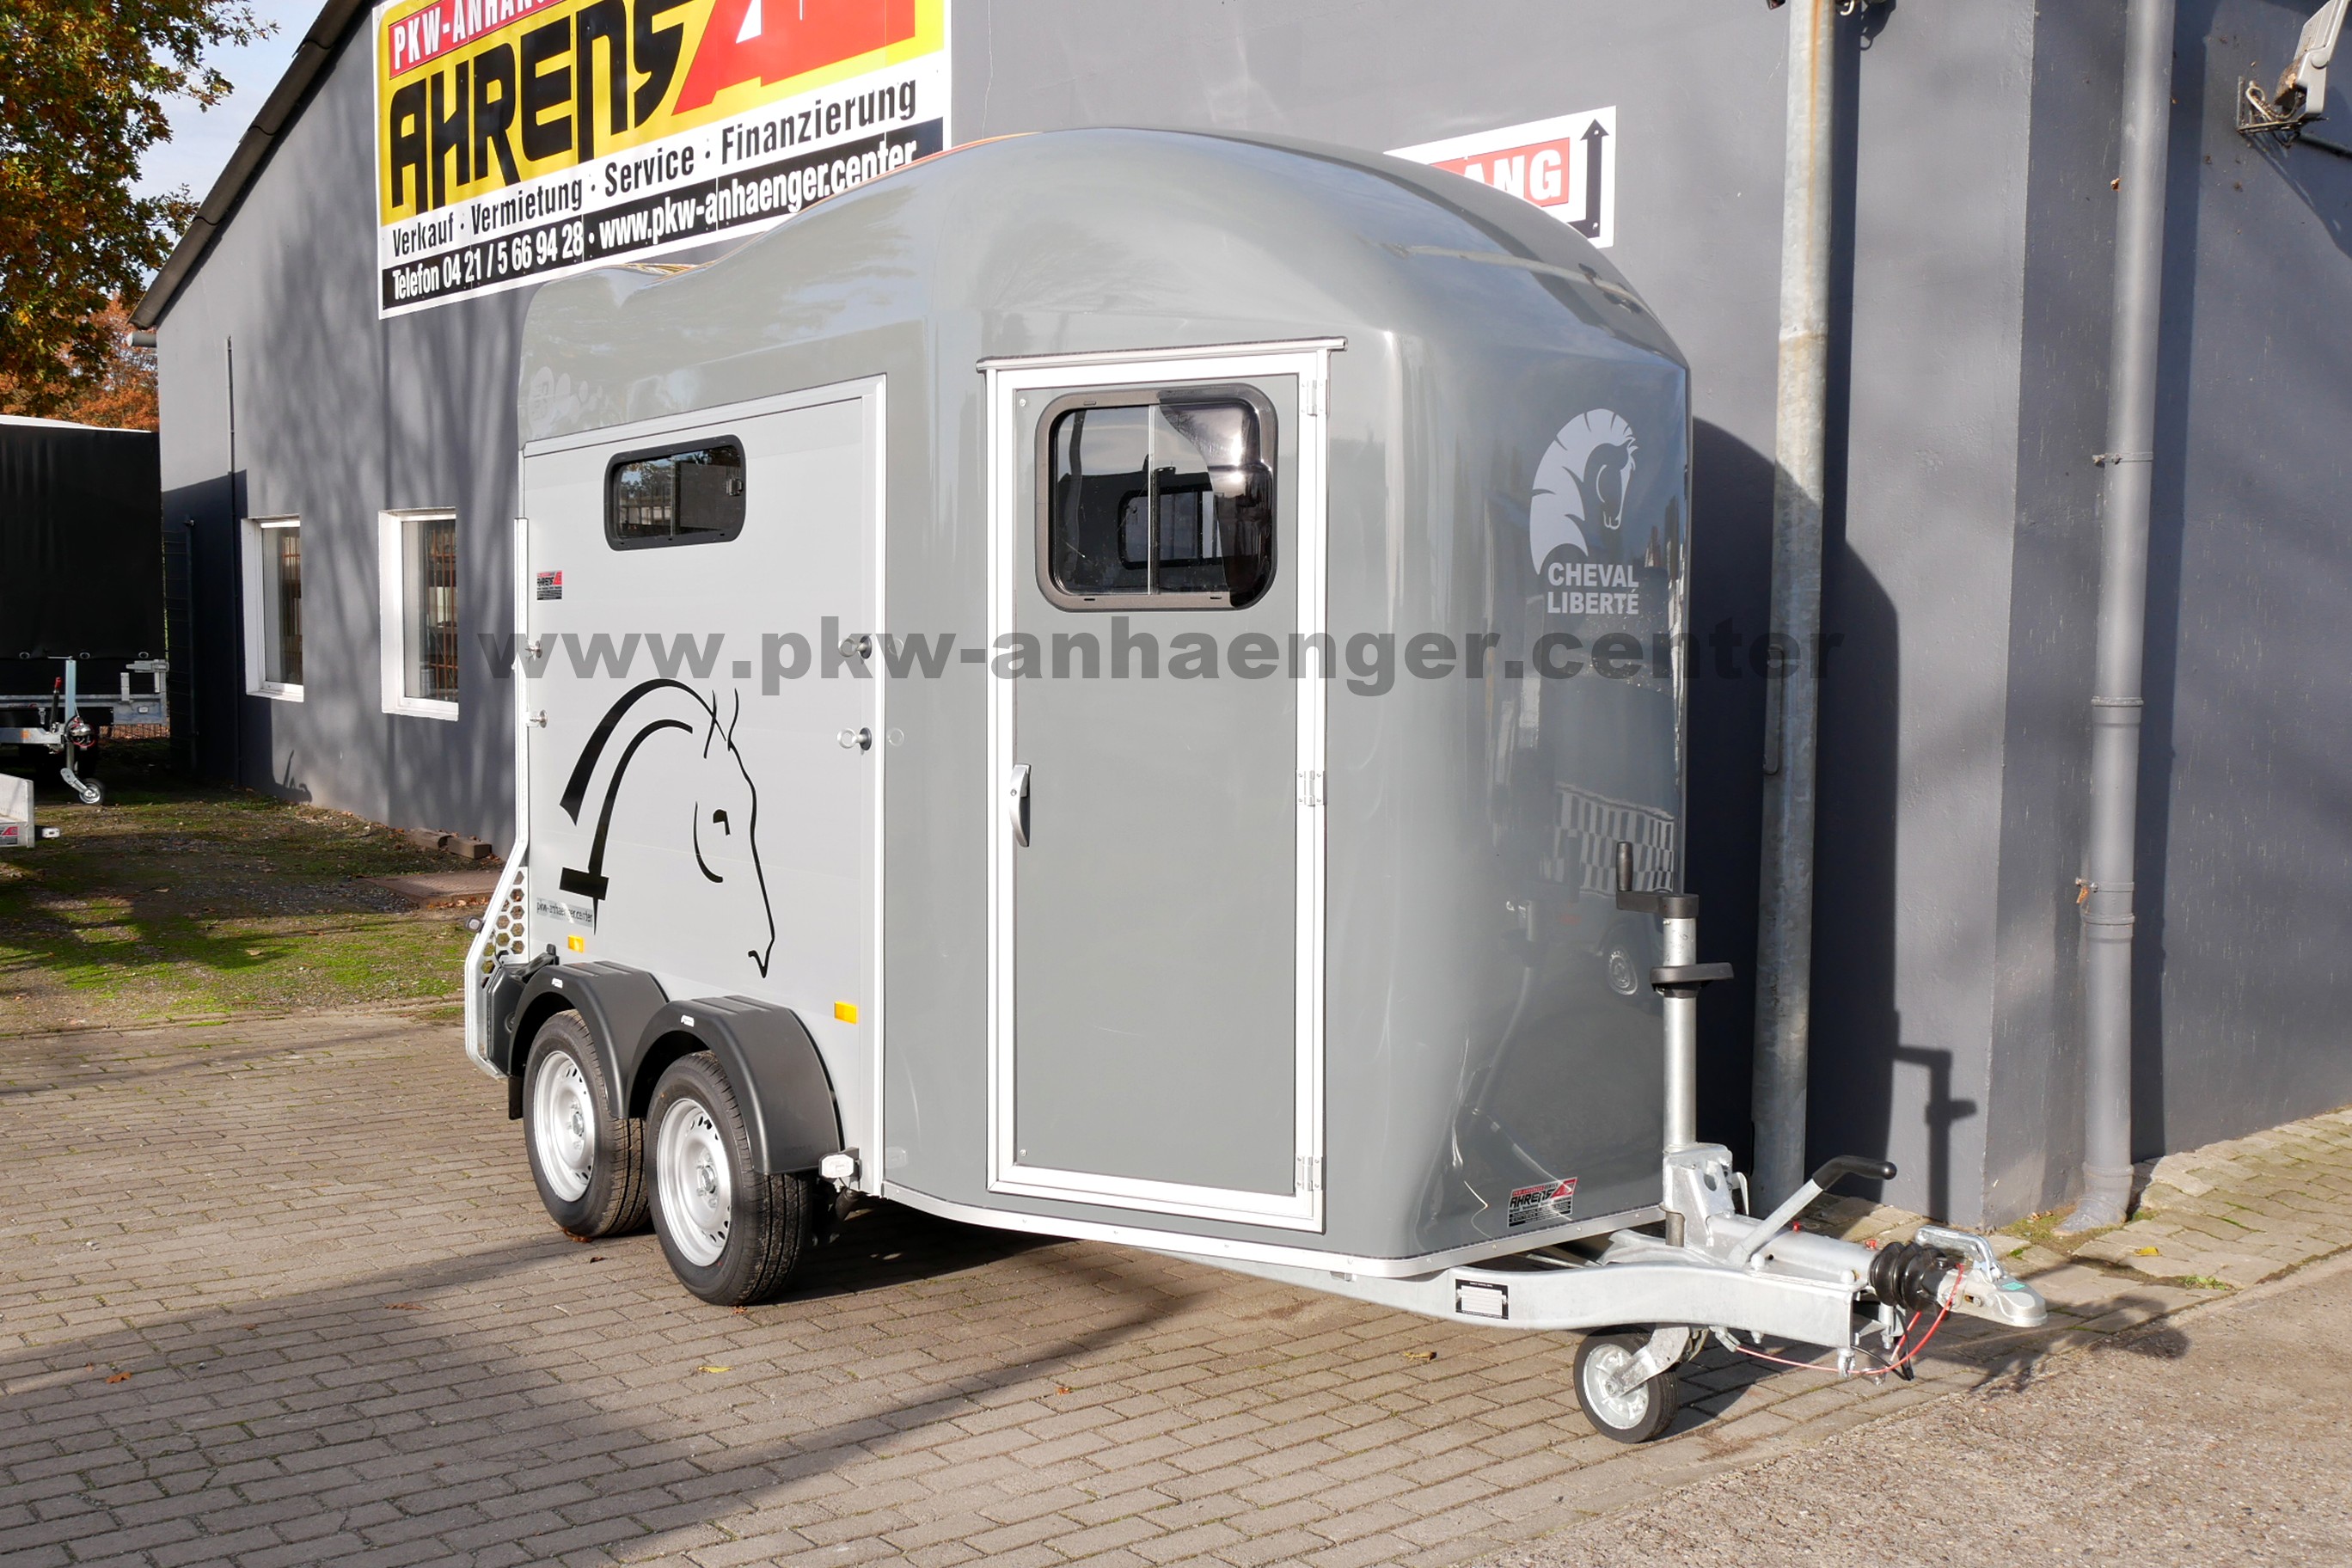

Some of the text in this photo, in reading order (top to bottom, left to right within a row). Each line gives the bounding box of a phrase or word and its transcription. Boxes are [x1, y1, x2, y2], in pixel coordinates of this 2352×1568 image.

[392, 79, 916, 257] Verkauf Vermietung Service Finanzierung
[392, 262, 440, 300] Telefon
[443, 254, 462, 288] 04
[464, 248, 482, 283] 21
[498, 241, 508, 275] 5
[511, 234, 533, 271] 66
[536, 227, 558, 265] 94
[561, 220, 584, 259] 28
[1548, 562, 1639, 587] CHEVAL
[1547, 588, 1639, 615] LIBERTÉ
